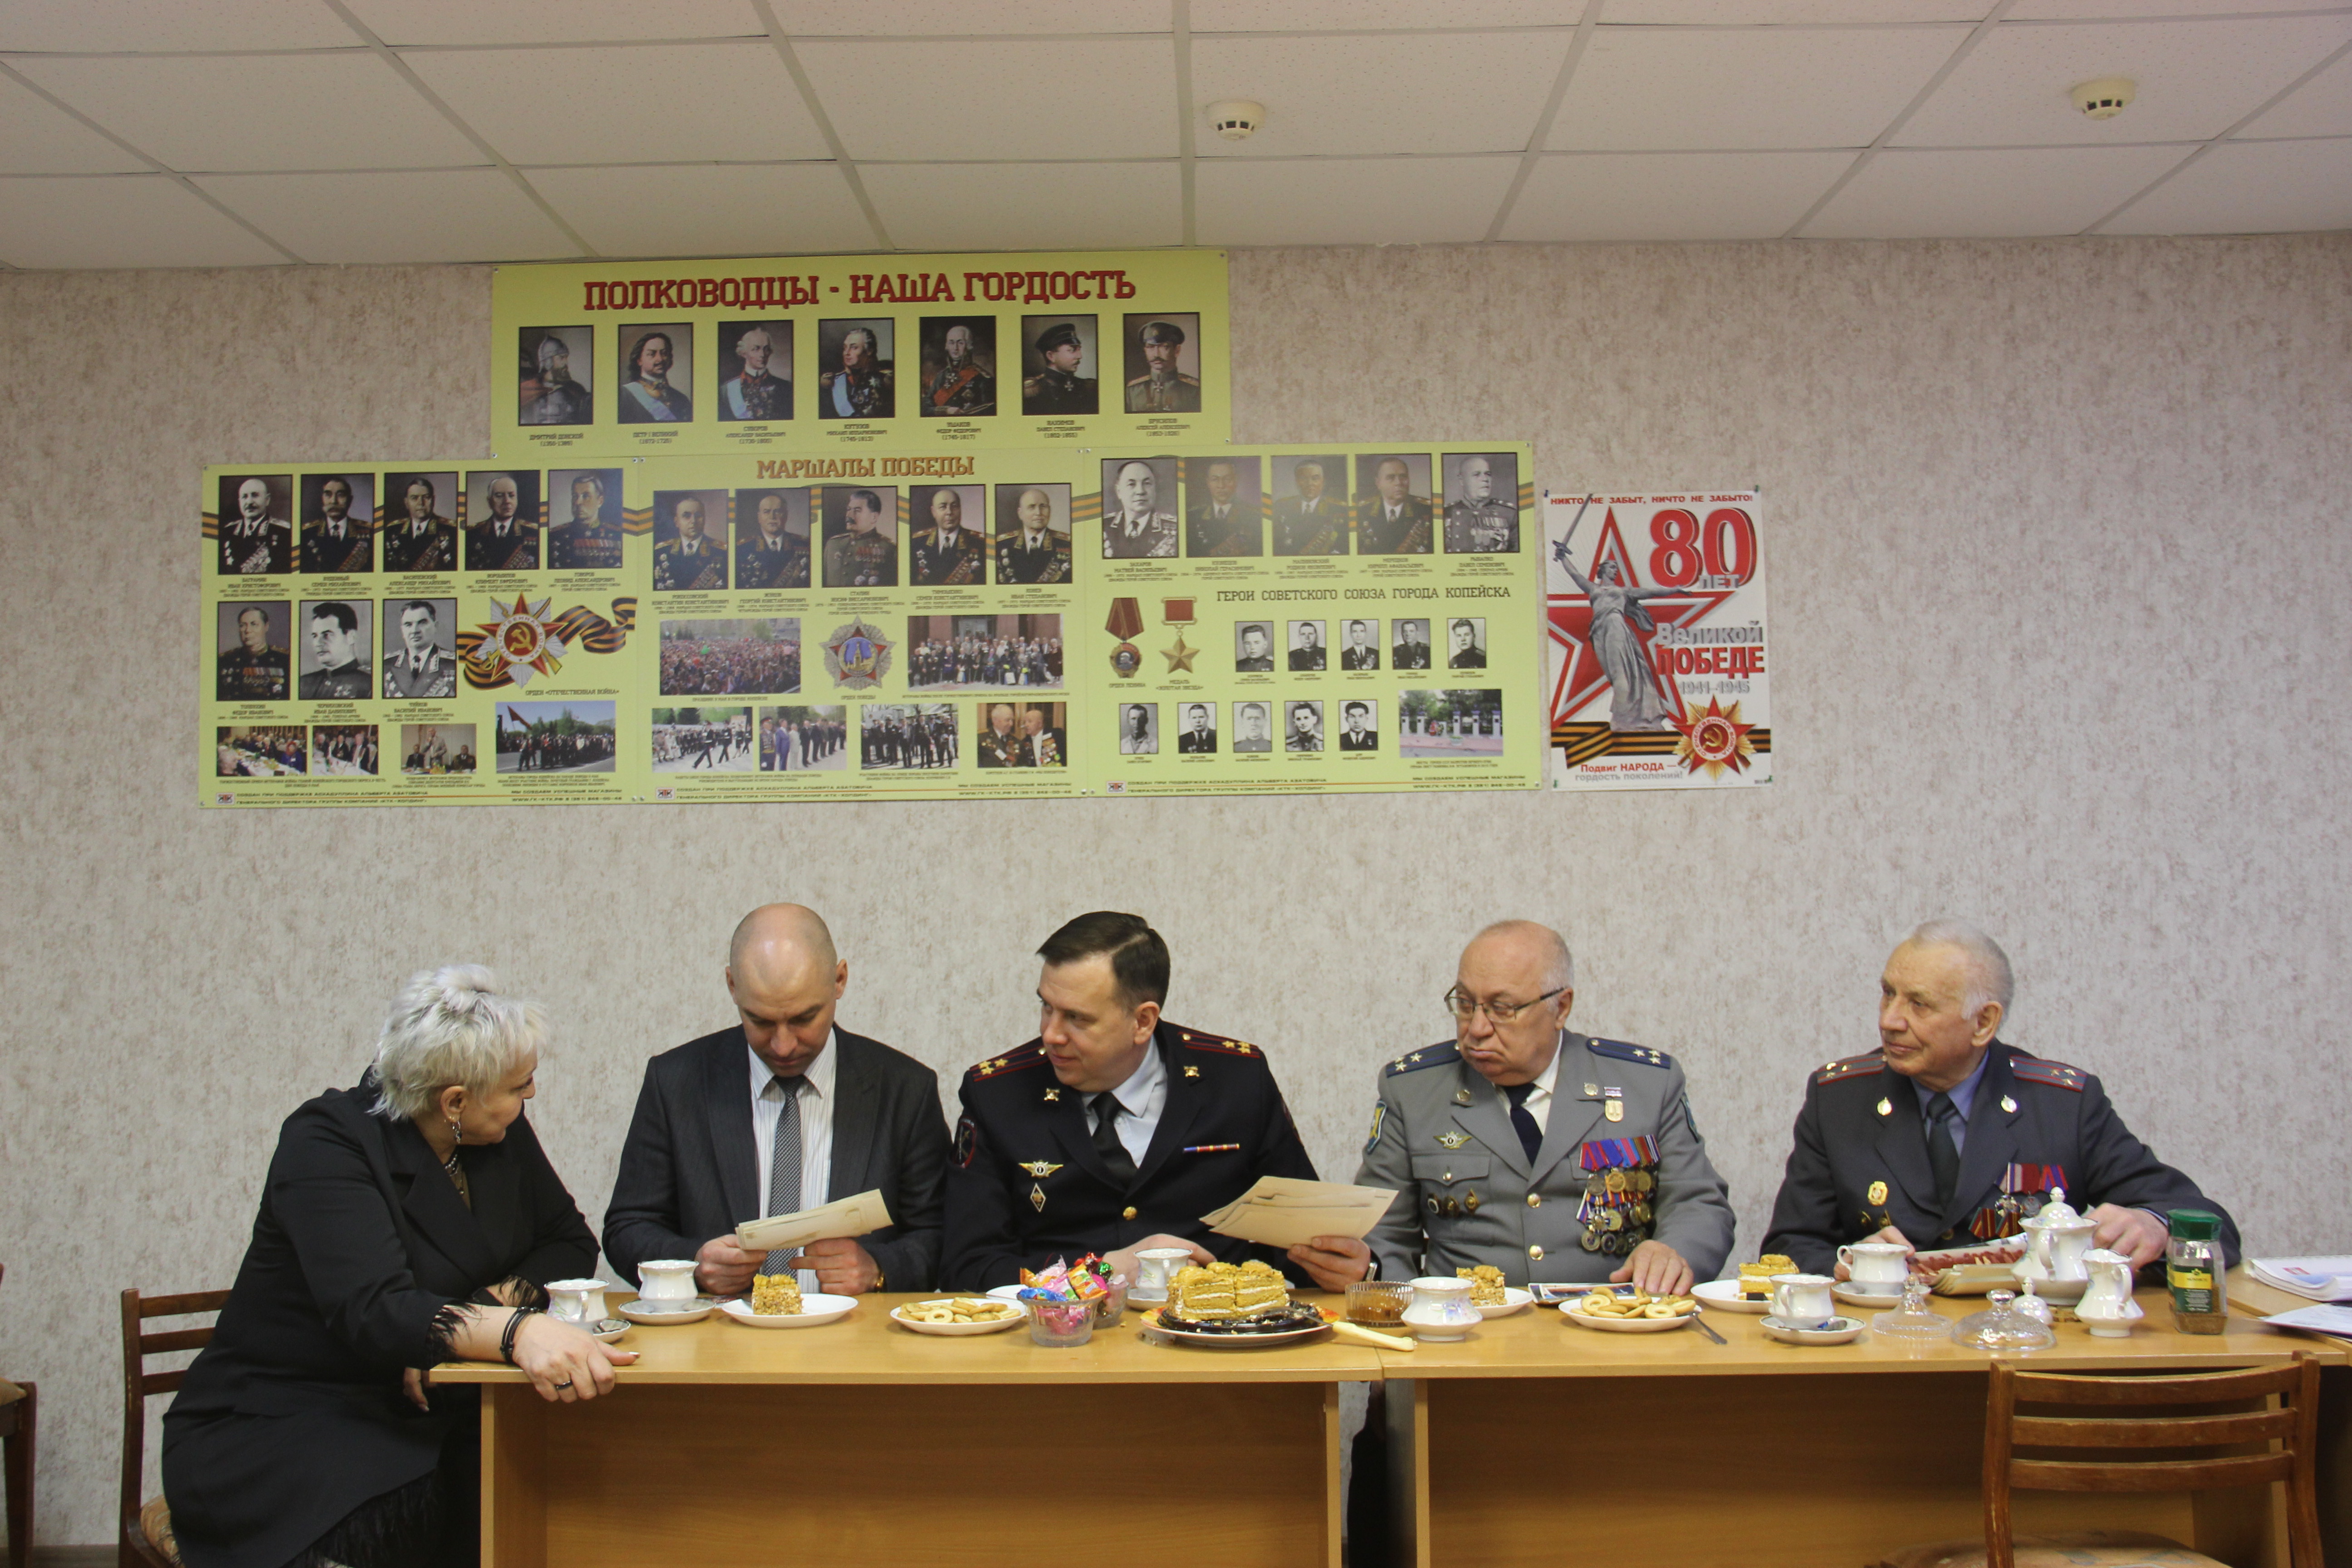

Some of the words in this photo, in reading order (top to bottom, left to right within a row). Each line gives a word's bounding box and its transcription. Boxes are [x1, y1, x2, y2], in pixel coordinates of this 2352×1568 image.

[583, 275, 819, 310] ПОЛКОВОДЦЫ
[849, 273, 955, 304] НАША
[964, 270, 1136, 305] ГОРДОСТЬ
[757, 457, 874, 480] МАРШАЛЫ
[881, 456, 974, 479] ПОБЕДЫ
[1649, 507, 1757, 588] 80
[1217, 590, 1255, 602] ГЕРОИ
[1262, 589, 1338, 601] СОВЕТСКОГО
[1344, 588, 1386, 599] СОЮЗА
[1392, 587, 1439, 601] ГОРОДА
[1446, 585, 1511, 598] КОПЕЙСКА
[1698, 574, 1743, 589] ЛЕТ
[1656, 621, 1763, 646] Великой
[1656, 646, 1764, 679] ПОБЕДЕ
[1575, 773, 1621, 782] гордость
[1581, 764, 1617, 773] Подвиг
[1620, 763, 1664, 771] НАРОДА
